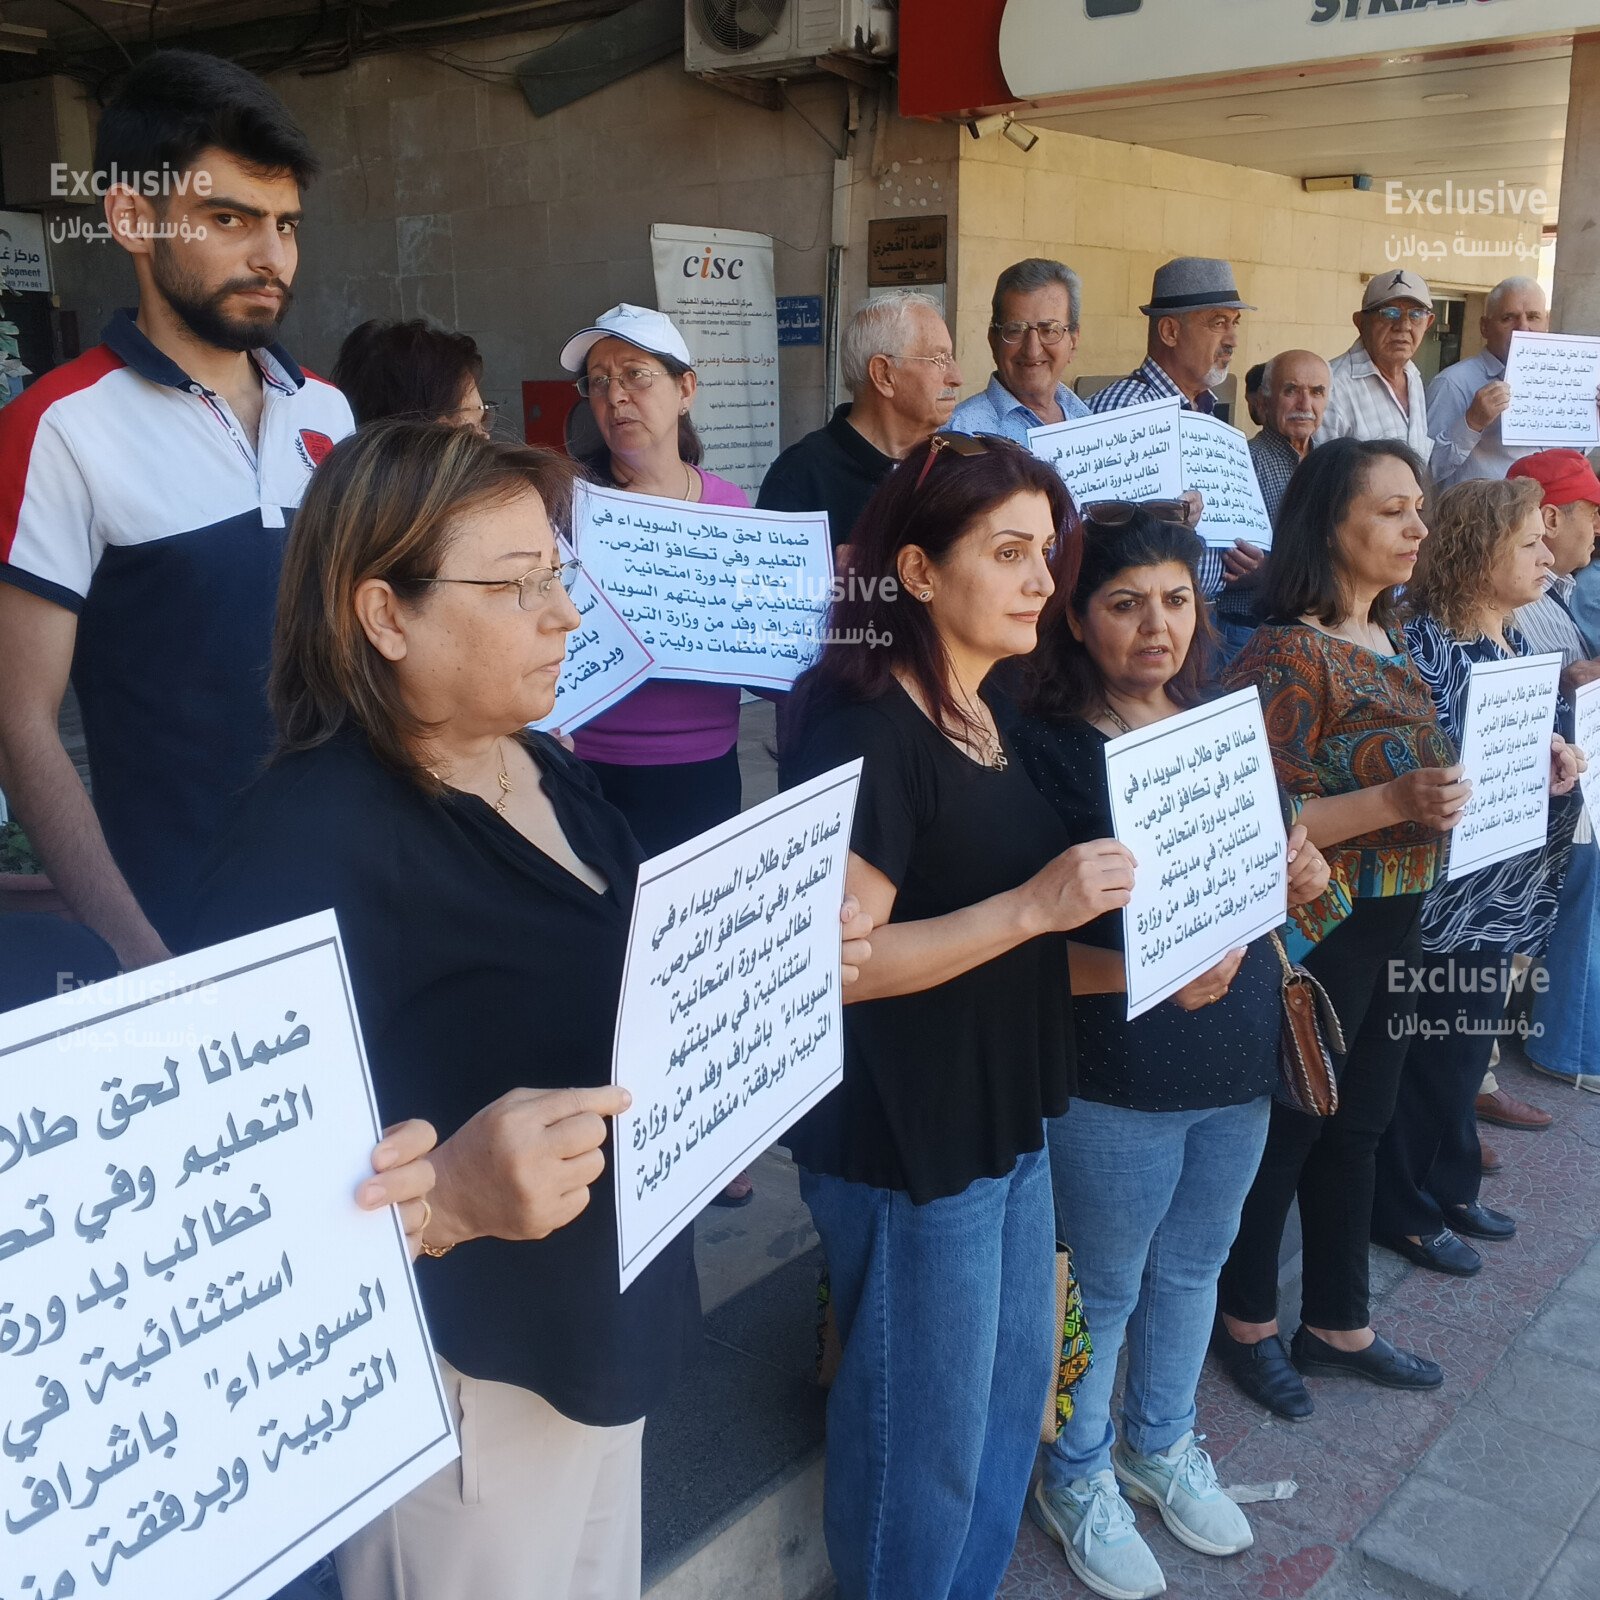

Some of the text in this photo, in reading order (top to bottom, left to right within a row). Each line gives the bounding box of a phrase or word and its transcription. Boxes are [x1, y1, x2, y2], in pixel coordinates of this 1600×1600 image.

[14, 249, 40, 264] مركز
[683, 247, 744, 280] cisc
[592, 508, 810, 546] ضمانا لحق طلاب السويداء في
[664, 541, 718, 560] تكافؤ
[722, 549, 750, 568] وفي
[755, 554, 807, 569] التعليم
[600, 578, 658, 598] السويدا
[624, 558, 787, 589] نطالب بدورة امتحانية
[663, 589, 727, 609] مدينتهم
[731, 594, 753, 613] في
[622, 606, 813, 641] باشراف وفد من وزارة الترب
[659, 632, 704, 653] دولية
[707, 638, 767, 655] منظمات
[564, 647, 624, 690] وبرفقة
[651, 812, 841, 952] ضمانا لحق طلاب السويداء في
[791, 854, 833, 902] التعليم
[765, 883, 789, 925] وفي
[713, 901, 764, 953] تكافؤ
[670, 911, 812, 1025] نطالب بدورة امتحانية
[665, 946, 811, 1076] استثنائية في مدينتهم
[726, 1019, 773, 1071] باشراف
[0, 1010, 311, 1175] ضمانا لحق طلا
[699, 1059, 722, 1094] وفد
[636, 1011, 831, 1201] التربية وبرفقة منظمات دولية
[673, 1085, 693, 1123] من
[174, 1083, 314, 1189] التعليم
[633, 1105, 668, 1151] وزارة
[74, 1162, 156, 1244] وفي
[143, 1182, 272, 1282] نطالب
[2, 1250, 293, 1464] استثنائية في
[0, 1347, 397, 1600] التربية وبرفقة من
[5, 1410, 178, 1535] باشراف
